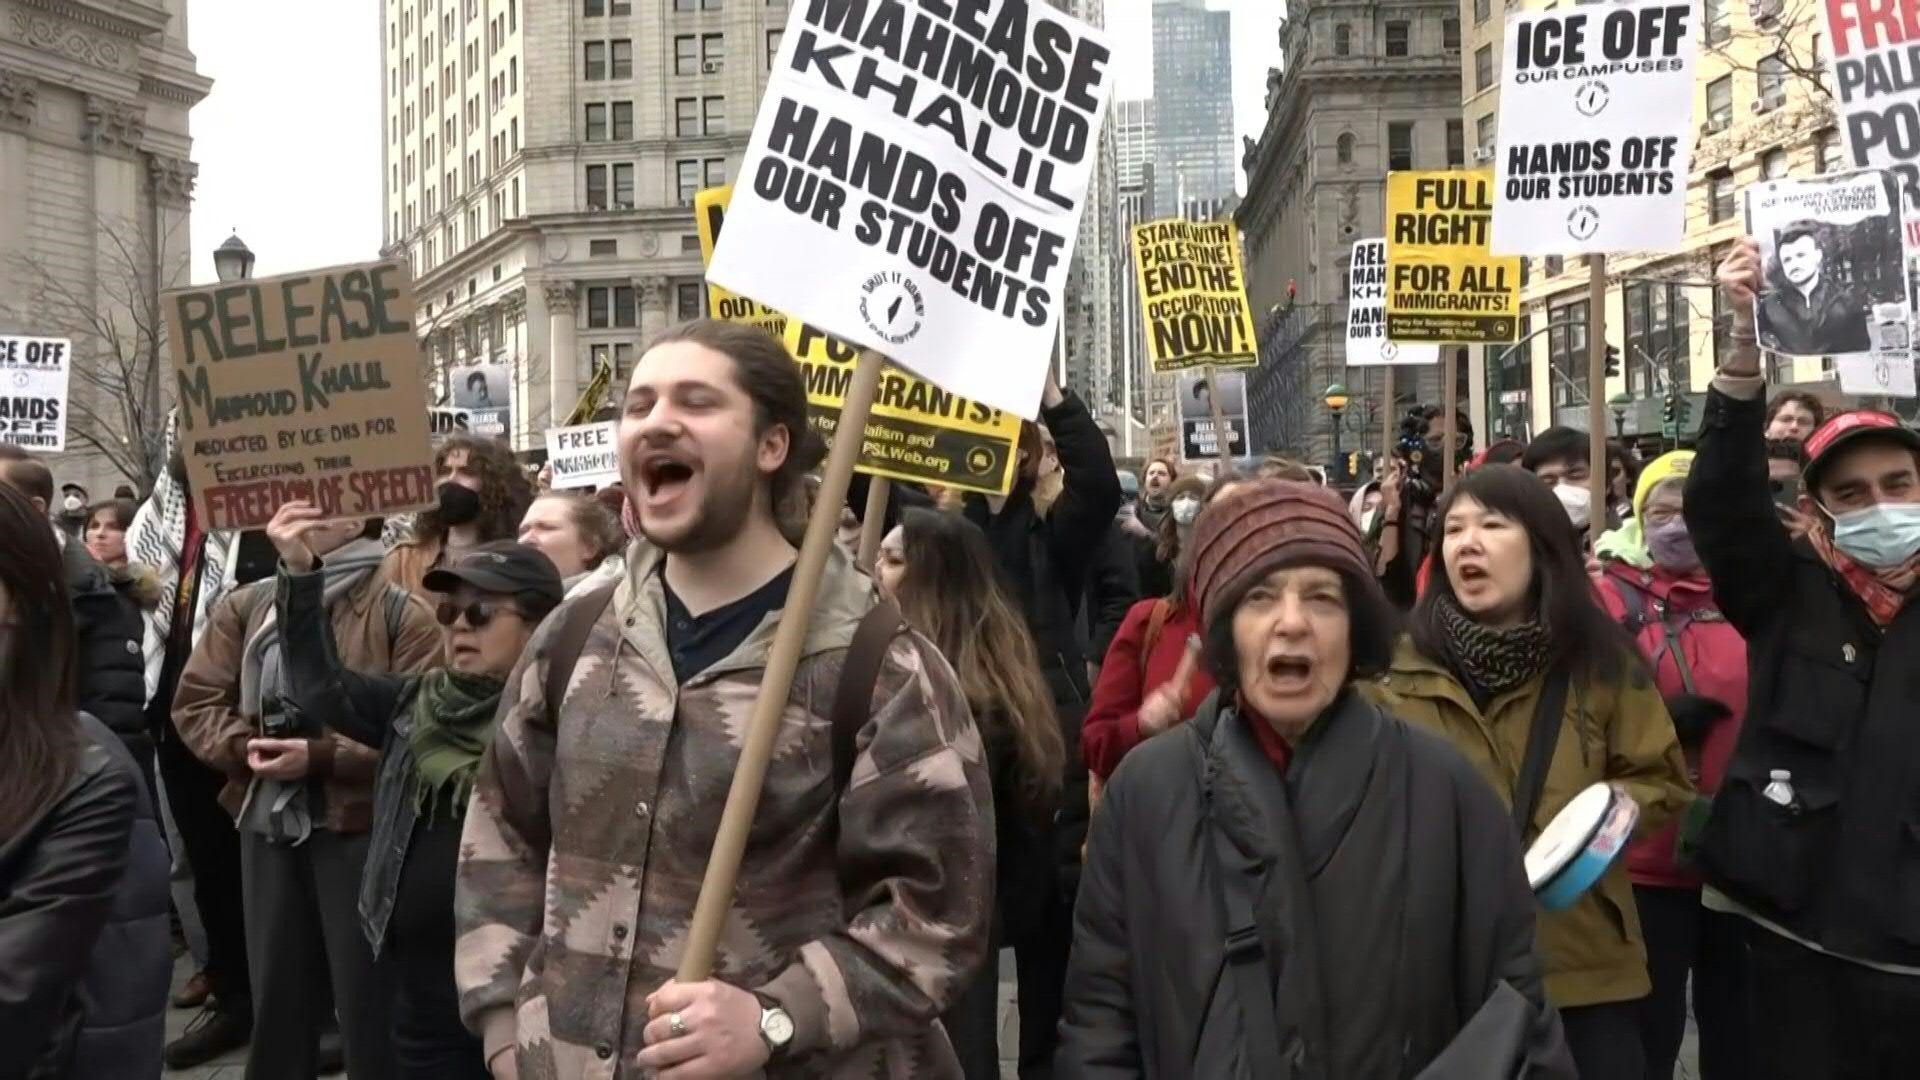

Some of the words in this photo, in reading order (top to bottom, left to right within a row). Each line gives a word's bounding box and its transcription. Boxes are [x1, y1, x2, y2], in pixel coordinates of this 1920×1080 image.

[1516, 15, 1587, 70] ICE
[1602, 5, 1691, 61] OFF
[918, 0, 1111, 114] EASE
[1515, 70, 1559, 84] OUR
[1563, 58, 1683, 80] CAMPUSES
[804, 0, 1090, 165] MAHMOUD
[790, 29, 1074, 211] KHALIL
[1847, 100, 1920, 167] PO
[1507, 138, 1611, 176] HANDS
[1621, 136, 1678, 170] OFF
[767, 97, 967, 234] HANDS
[973, 202, 1066, 284] OFF
[1416, 178, 1492, 210] FULL
[1505, 177, 1551, 202] OUR
[1558, 170, 1674, 199] STUDENTS
[754, 156, 847, 231] OUR
[855, 200, 1051, 327] STUDENTS
[1137, 223, 1190, 247] STAND
[1190, 224, 1230, 244] WITH
[1395, 213, 1492, 246] RIGHT
[1141, 242, 1233, 269] PALESTINE!
[1354, 243, 1387, 266] REL
[1144, 262, 1196, 298] END
[1197, 265, 1240, 293] THE
[1352, 267, 1387, 285] MAH
[1394, 265, 1451, 292] FOR
[1459, 265, 1512, 293] ALL
[176, 264, 410, 364] RELEASE
[1148, 294, 1243, 320] OCCUPATION
[1351, 307, 1387, 324] HAN
[1394, 293, 1509, 312] IMMIGRANTS!
[1153, 312, 1250, 359] NOW!
[1350, 325, 1371, 338] OUR
[26, 341, 65, 365] OFF
[0, 397, 59, 421] ANDS
[4, 433, 58, 446] STUDENTS
[278, 429, 296, 450] BY
[366, 417, 396, 437] FOR
[558, 428, 609, 450] FREE
[908, 434, 935, 449] and
[862, 441, 950, 472] PSLWeb.org
[319, 475, 345, 516] OF
[350, 464, 433, 514] SPEECH
